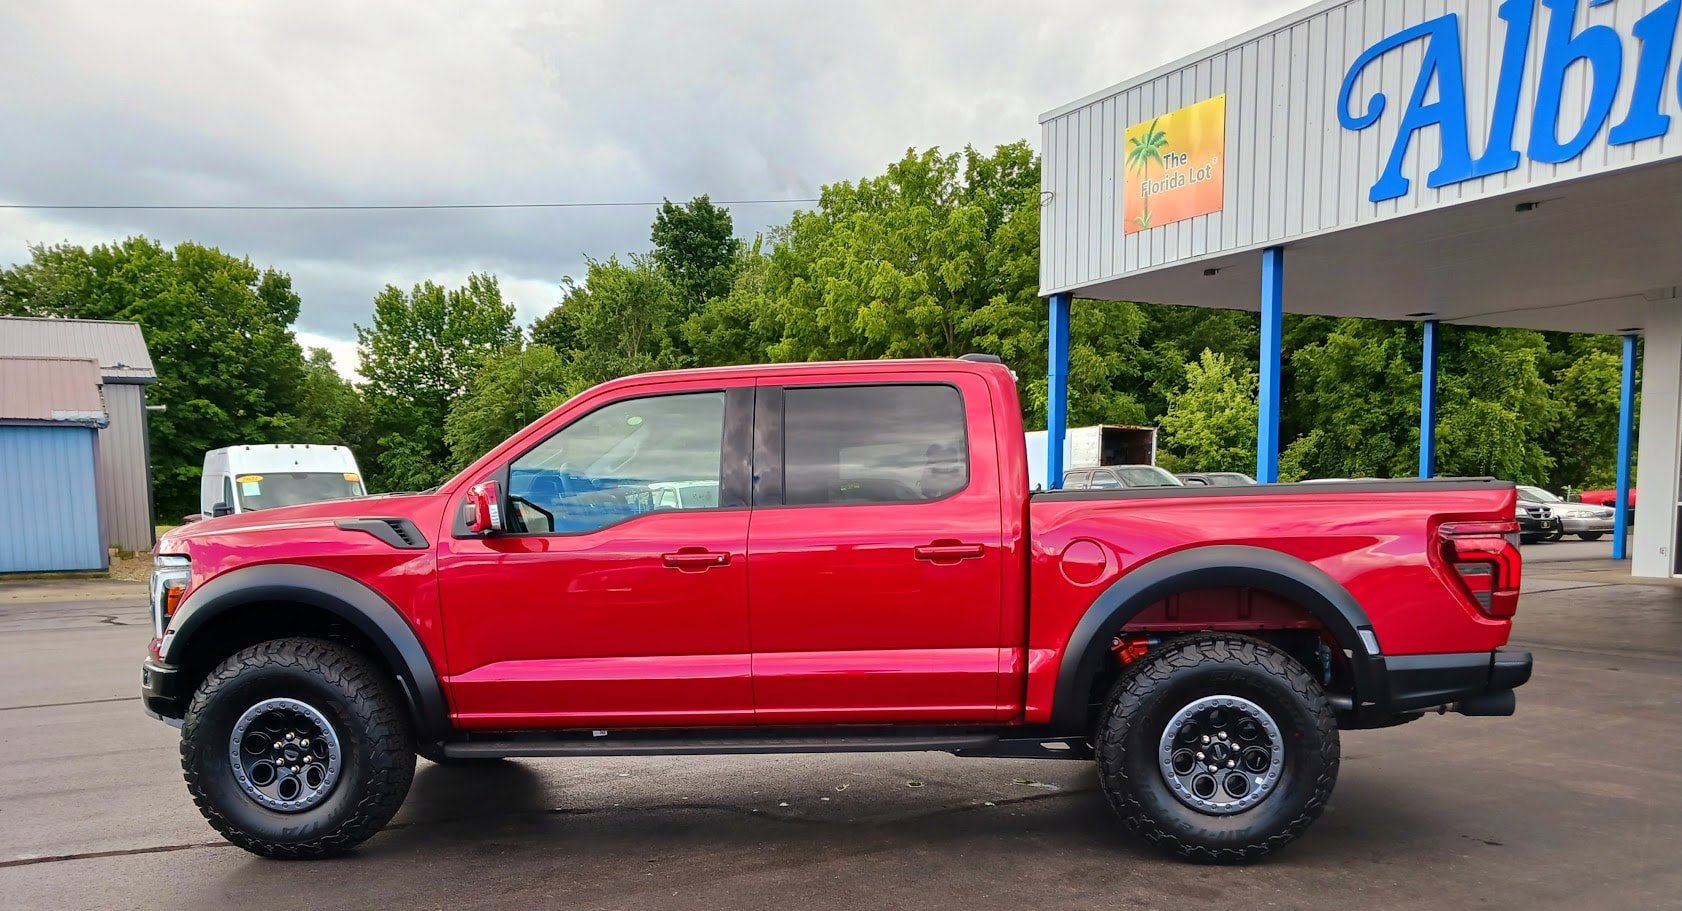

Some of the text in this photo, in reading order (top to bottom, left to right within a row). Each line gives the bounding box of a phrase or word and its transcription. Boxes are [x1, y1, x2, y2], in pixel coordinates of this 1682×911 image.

[1337, 0, 1682, 202] Albi
[1163, 152, 1188, 170] The
[1141, 164, 1212, 197] Florida Lot
